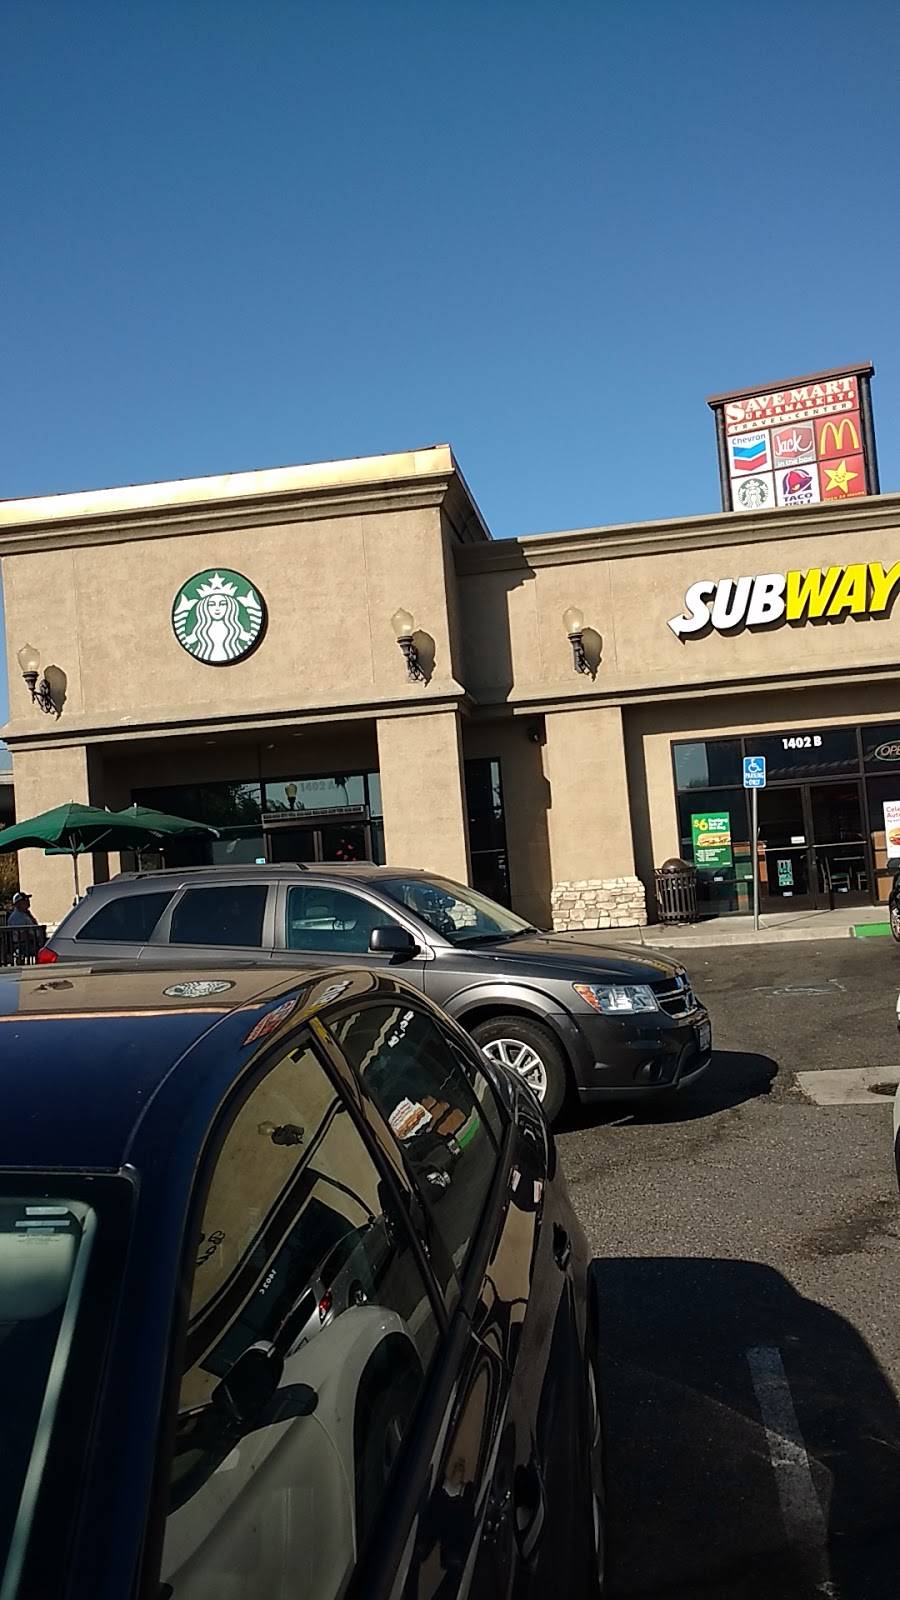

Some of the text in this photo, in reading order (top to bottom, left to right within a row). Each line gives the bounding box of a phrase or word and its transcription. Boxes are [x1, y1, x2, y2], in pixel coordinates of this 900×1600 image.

[726, 379, 852, 422] SAVE MART
[732, 433, 766, 445] Chevron
[775, 429, 813, 456] Jack
[784, 492, 813, 502] TACO
[667, 560, 900, 637] SUBWAY
[782, 735, 822, 750] 1402 B
